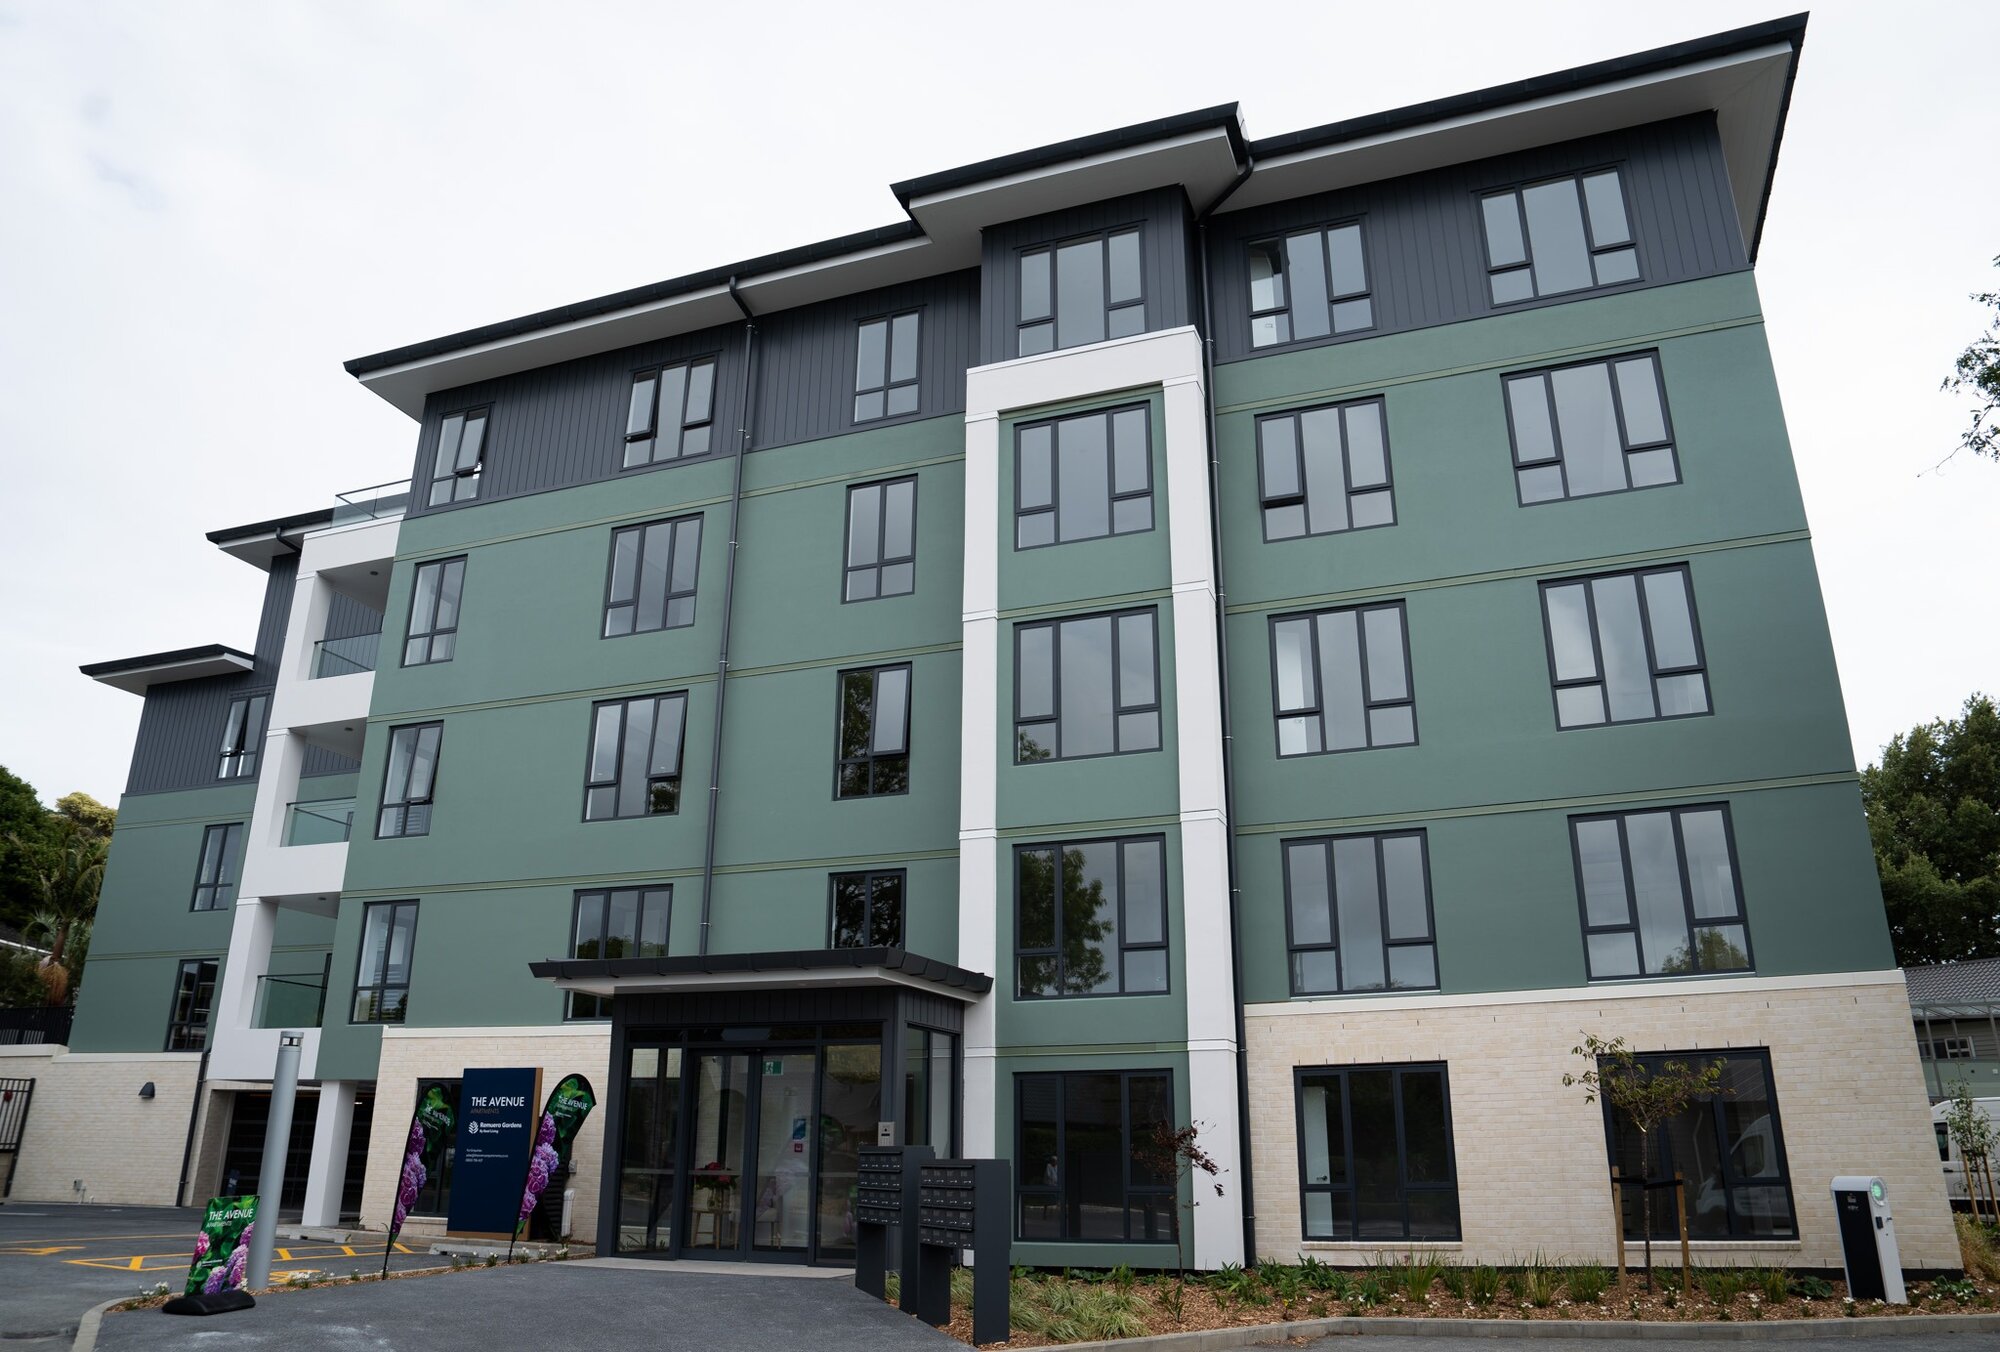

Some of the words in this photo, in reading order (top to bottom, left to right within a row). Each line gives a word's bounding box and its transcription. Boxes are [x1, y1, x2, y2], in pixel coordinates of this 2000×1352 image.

[471, 1096, 487, 1107] THE
[488, 1096, 525, 1107] AVENUE
[567, 1099, 588, 1110] AVENUE
[209, 1210, 223, 1221] THE
[222, 1208, 254, 1220] AVENUE
